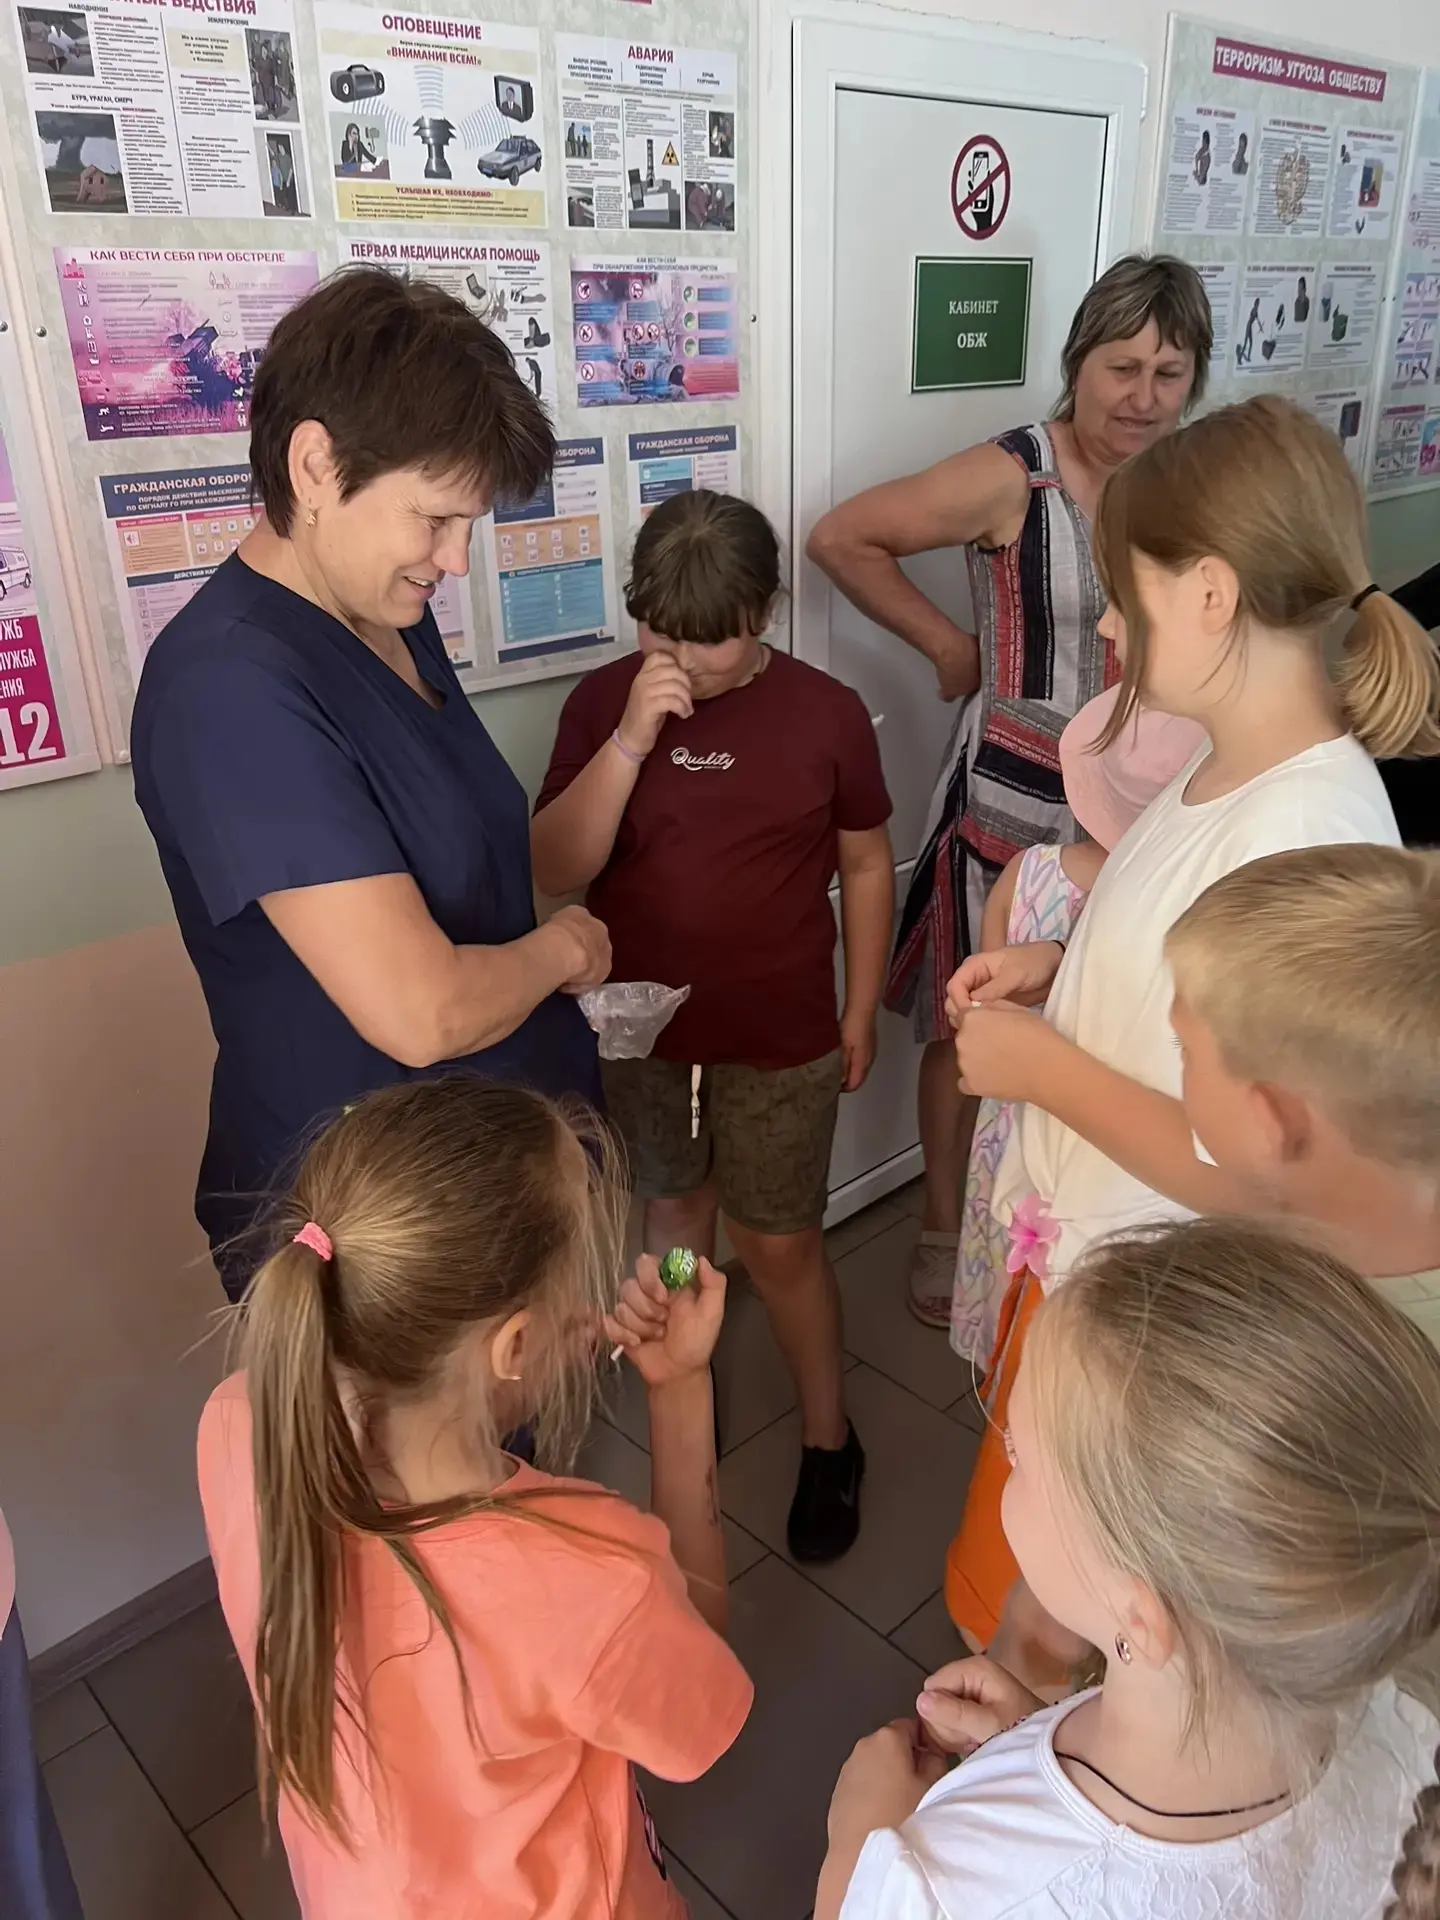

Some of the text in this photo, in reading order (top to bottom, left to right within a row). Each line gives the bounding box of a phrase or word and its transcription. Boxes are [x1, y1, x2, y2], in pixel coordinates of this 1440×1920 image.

[171, 0, 257, 15] БЕДСТВИЯ
[382, 14, 482, 40] ОПОВЕЩЕНИЕ
[628, 45, 674, 63] АВАРИЯ
[1286, 60, 1325, 84] УГРОЗА
[1328, 69, 1383, 95] ОБЩЕСТВУ
[90, 250, 286, 263] КАК ВЕСТИ СЕБЯ ПРИ ОБСТРЕЛЕ
[350, 243, 541, 264] ПЕРВАЯ МЕДИЦИНСКАЯ ПОМОЩЬ
[948, 300, 999, 315] КАБИНЕТ
[957, 332, 988, 349] ОБЖ
[636, 437, 693, 450] ГРАЖДАНСКАЯ
[694, 434, 730, 445] ОБОРОНА
[113, 472, 252, 494] ГРАЖДАНСКАЯ ОБОРО
[126, 504, 137, 512] ПО
[0, 618, 23, 641] ЖБ
[670, 746, 736, 771] Quality
